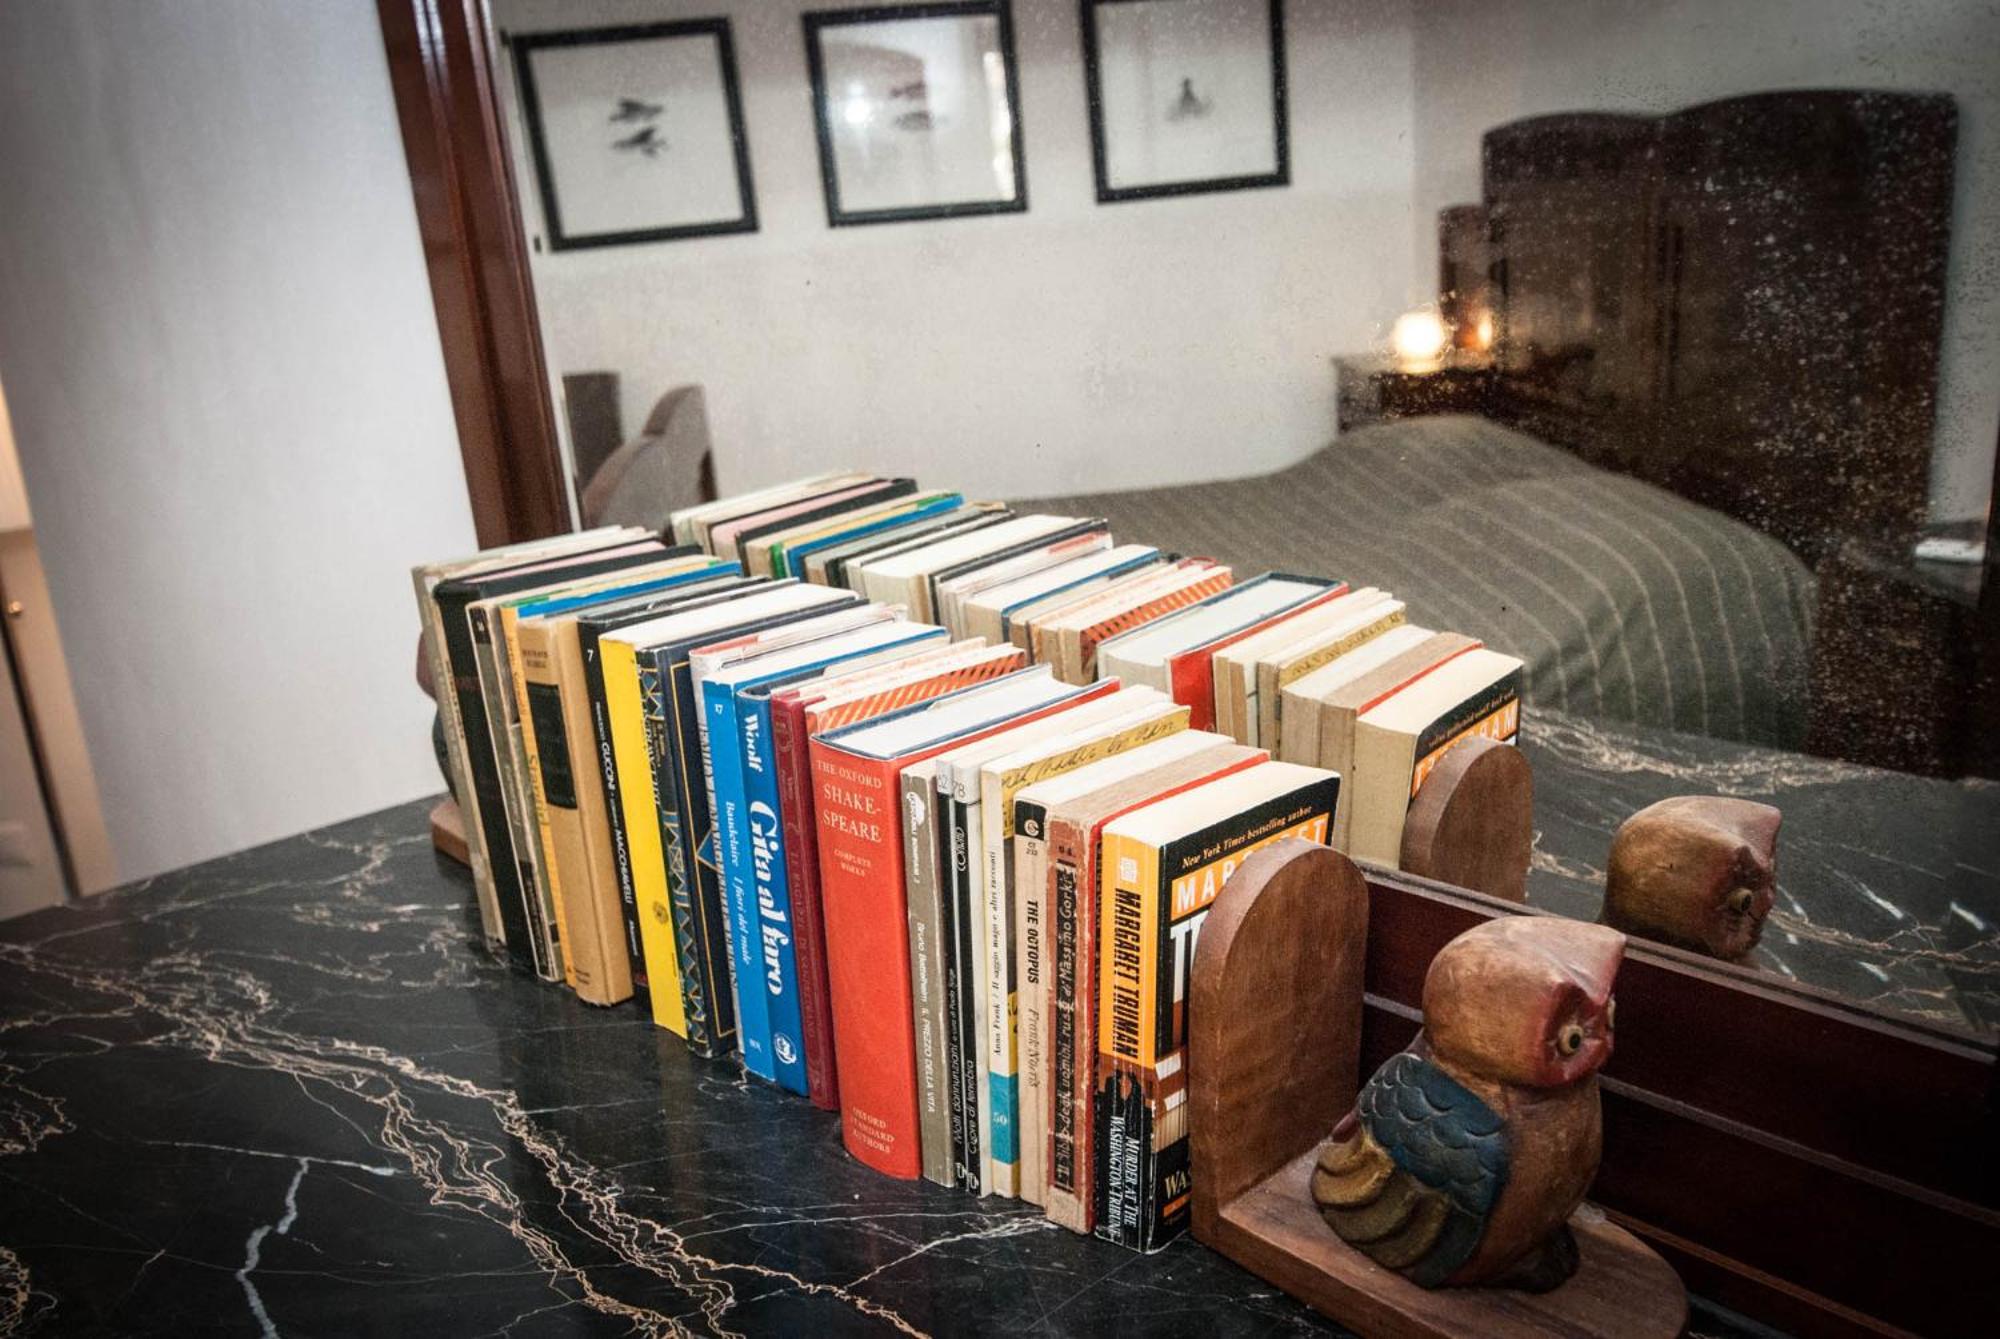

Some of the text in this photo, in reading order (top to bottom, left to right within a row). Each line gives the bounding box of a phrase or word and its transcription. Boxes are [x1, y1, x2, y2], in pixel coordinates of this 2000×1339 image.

[587, 649, 594, 662] 7
[744, 714, 763, 772] Woolf
[817, 760, 881, 789] THE OXFORD
[823, 783, 881, 815] SHAKE-
[601, 742, 616, 791] GUCCINI
[614, 829, 633, 904] MACCHIAVELLI
[823, 810, 881, 843] SPEARE
[1183, 806, 1312, 868] New York Times bestselling author
[834, 848, 871, 868] COMPLETE
[841, 863, 865, 878] WORKS
[726, 801, 752, 965] Baudelaire I fiori del male
[750, 801, 789, 996] Gita al faro
[1059, 876, 1073, 918] Gorki
[917, 922, 925, 951] Bruno
[992, 922, 1000, 948] mago
[1027, 900, 1039, 984] THE OCTOPUS
[1060, 922, 1075, 979] Massimo
[1064, 981, 1073, 996] di
[1112, 888, 1141, 1059] MARGARET TRUMAN
[992, 1003, 1001, 1030] Frank
[1028, 1008, 1040, 1047] Frank
[922, 1018, 933, 1058] PREZZO
[992, 1032, 1001, 1056] Anna
[924, 1059, 933, 1091] DELLA
[1059, 1043, 1074, 1087] uomini
[966, 1060, 977, 1154] Cuore di tenebra
[1108, 1116, 1124, 1240] WASHINGTON TRIBUNE
[1124, 1136, 1140, 1228] MURDER AT THE
